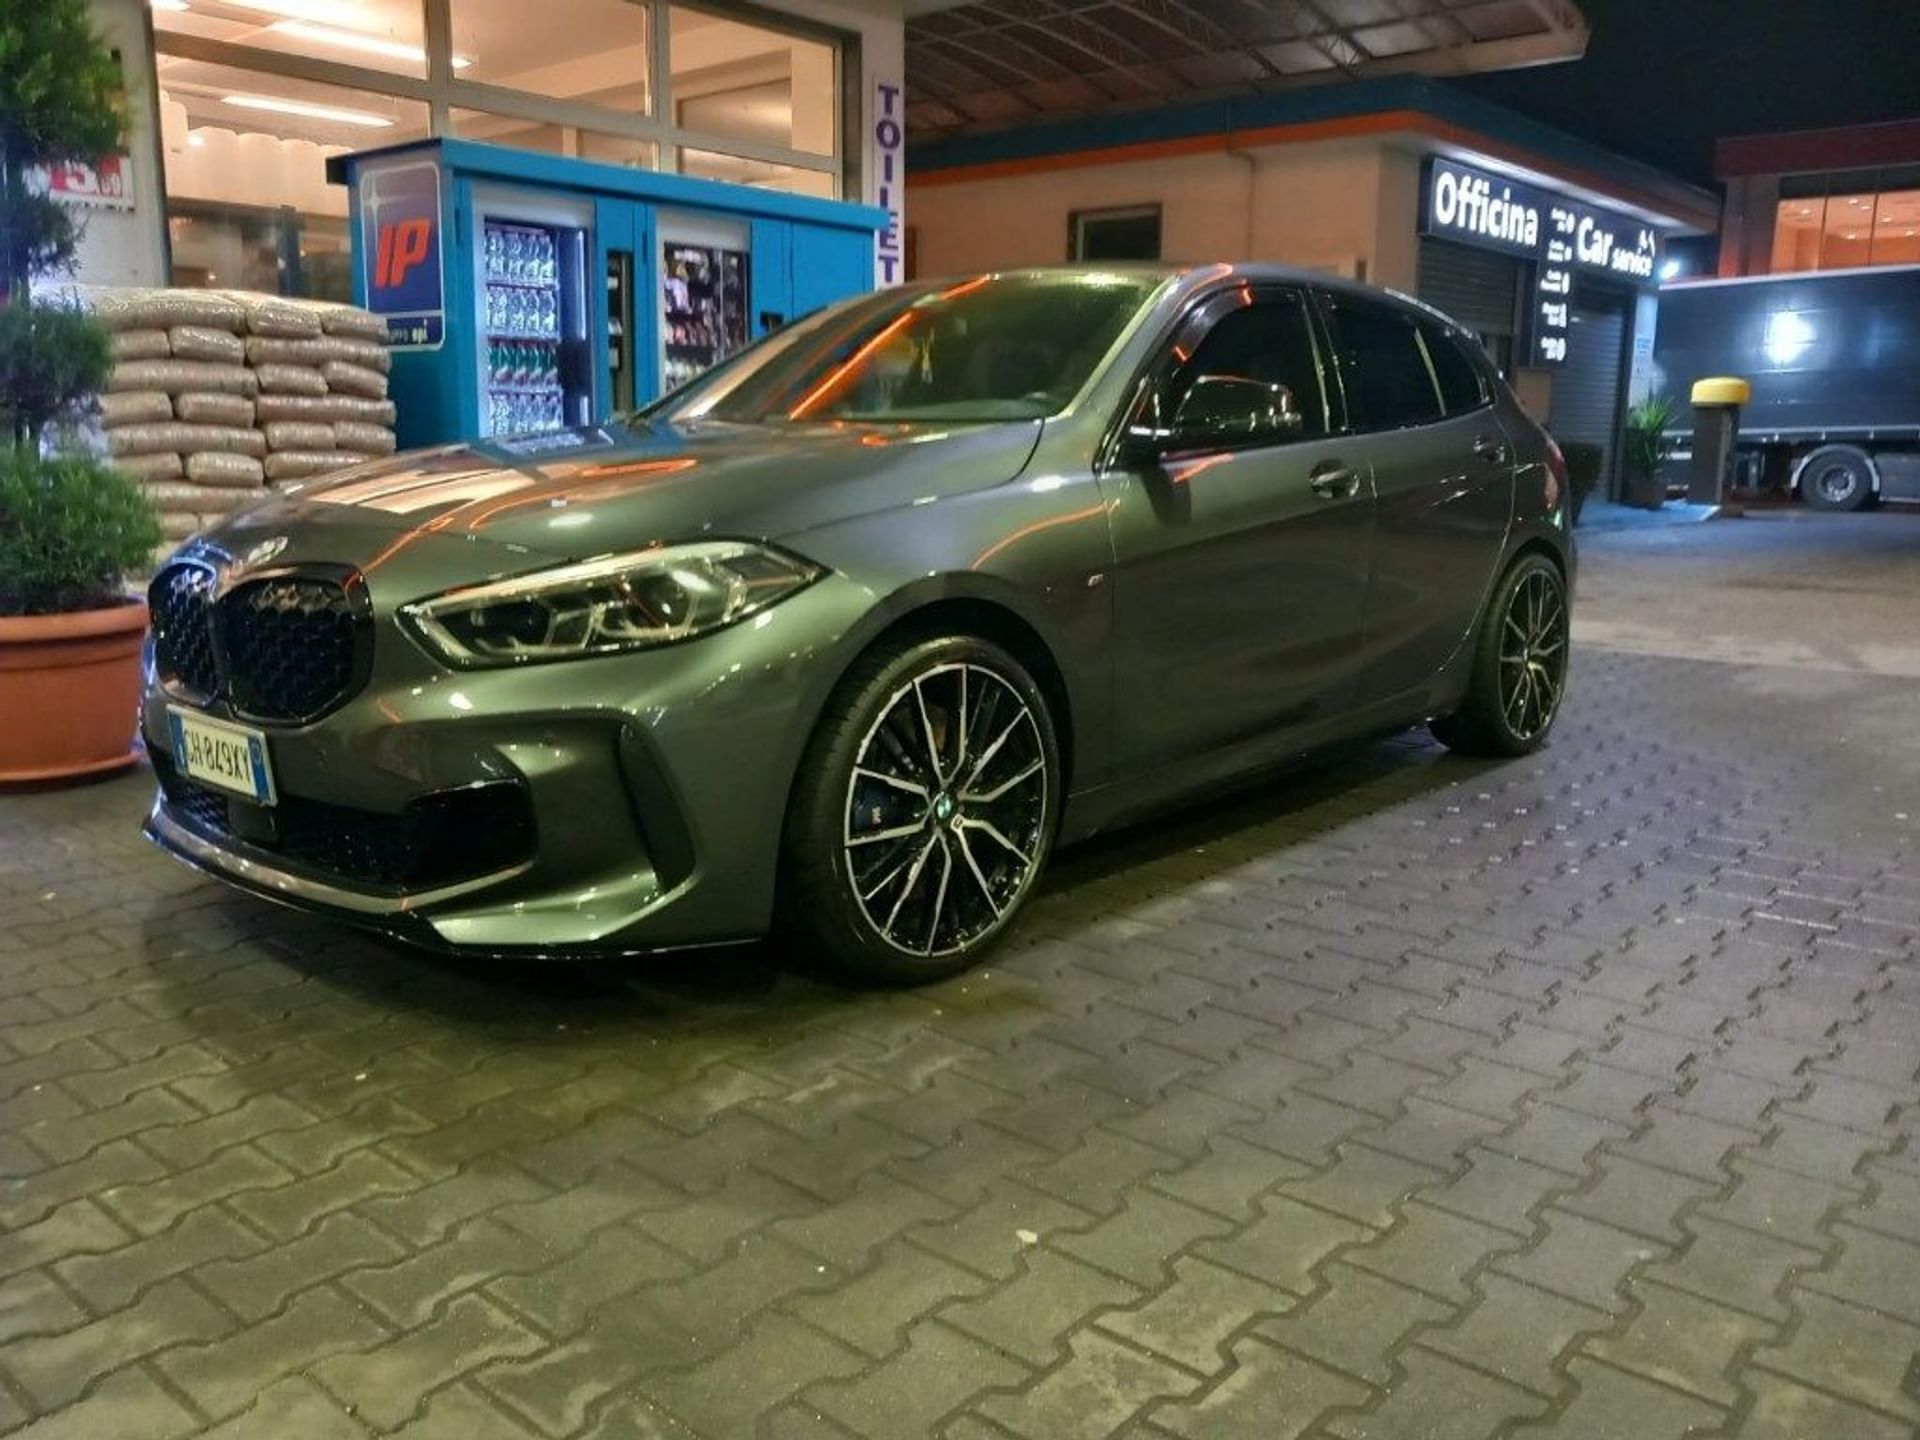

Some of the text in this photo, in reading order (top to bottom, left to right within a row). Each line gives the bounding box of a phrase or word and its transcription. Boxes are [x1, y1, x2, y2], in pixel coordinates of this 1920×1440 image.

[876, 84, 901, 283] TOILET
[1435, 171, 1539, 246] Officina
[374, 218, 431, 288] IP
[1577, 216, 1614, 266] Car
[1611, 247, 1653, 277] service
